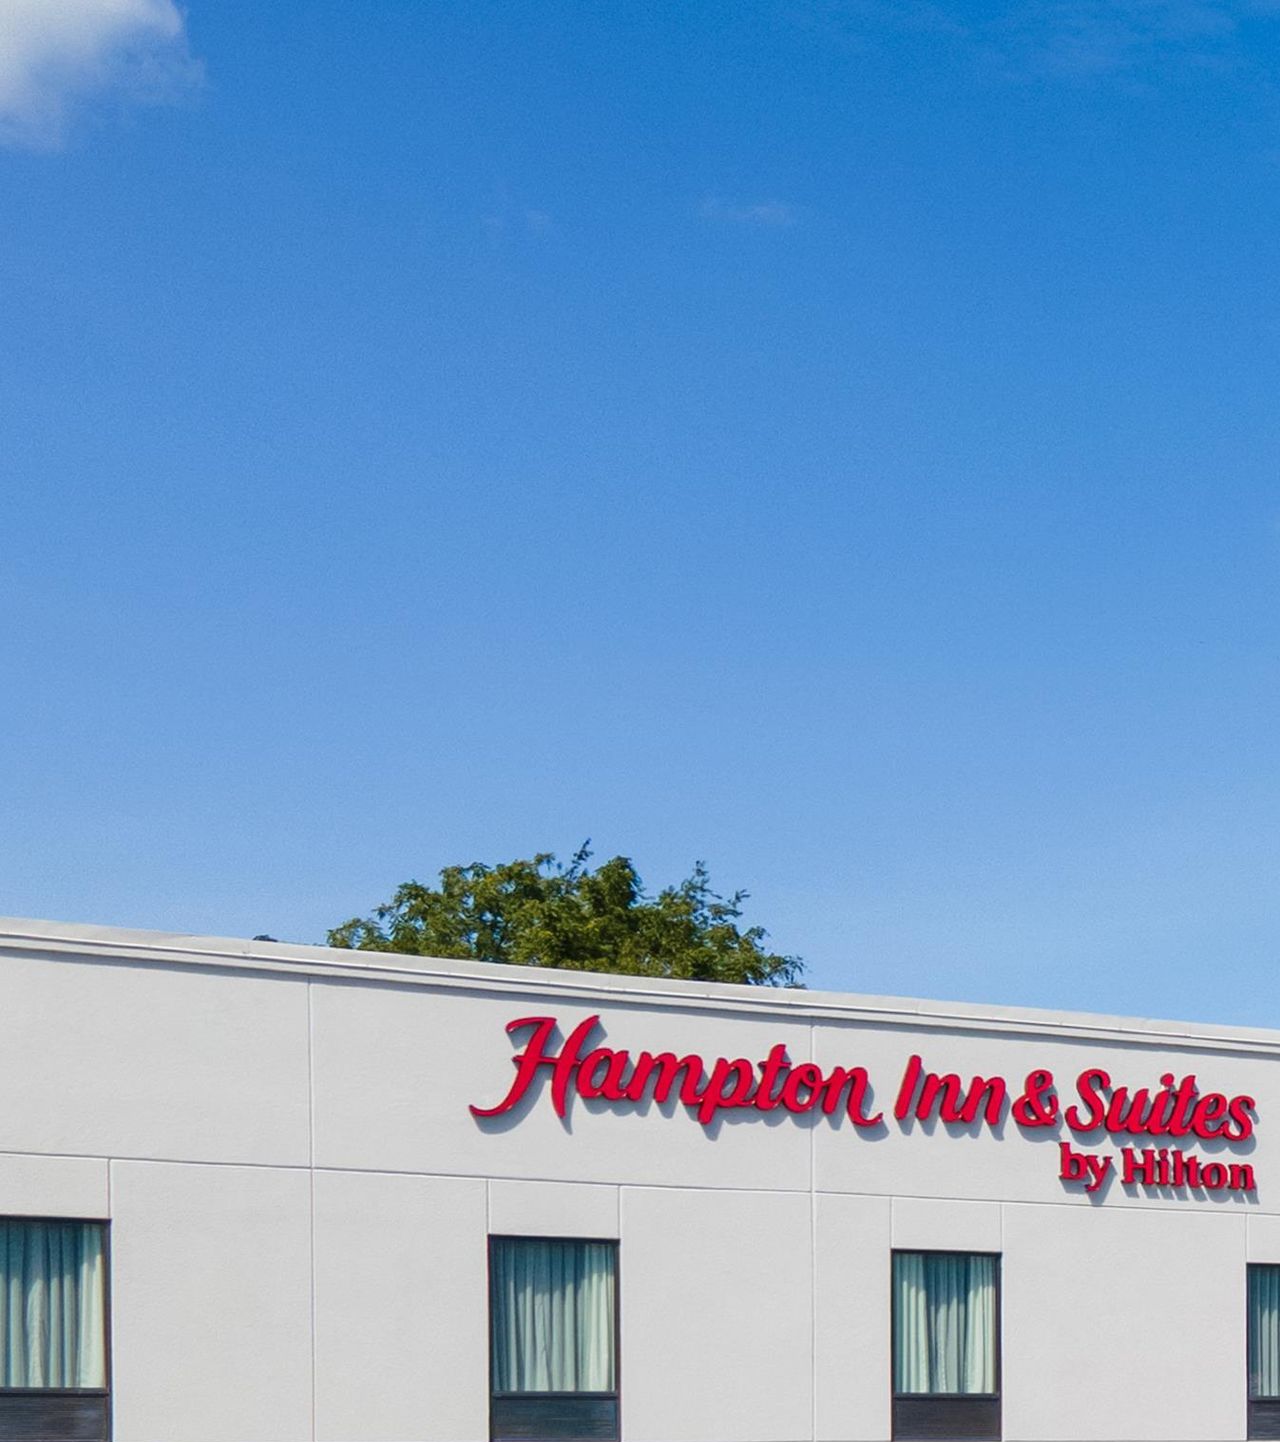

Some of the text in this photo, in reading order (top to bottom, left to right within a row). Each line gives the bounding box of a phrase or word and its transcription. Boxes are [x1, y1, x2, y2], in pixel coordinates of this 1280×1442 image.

[469, 1014, 1257, 1142] Hampton Inn & Suites
[1058, 1142, 1257, 1193] by Hilton
